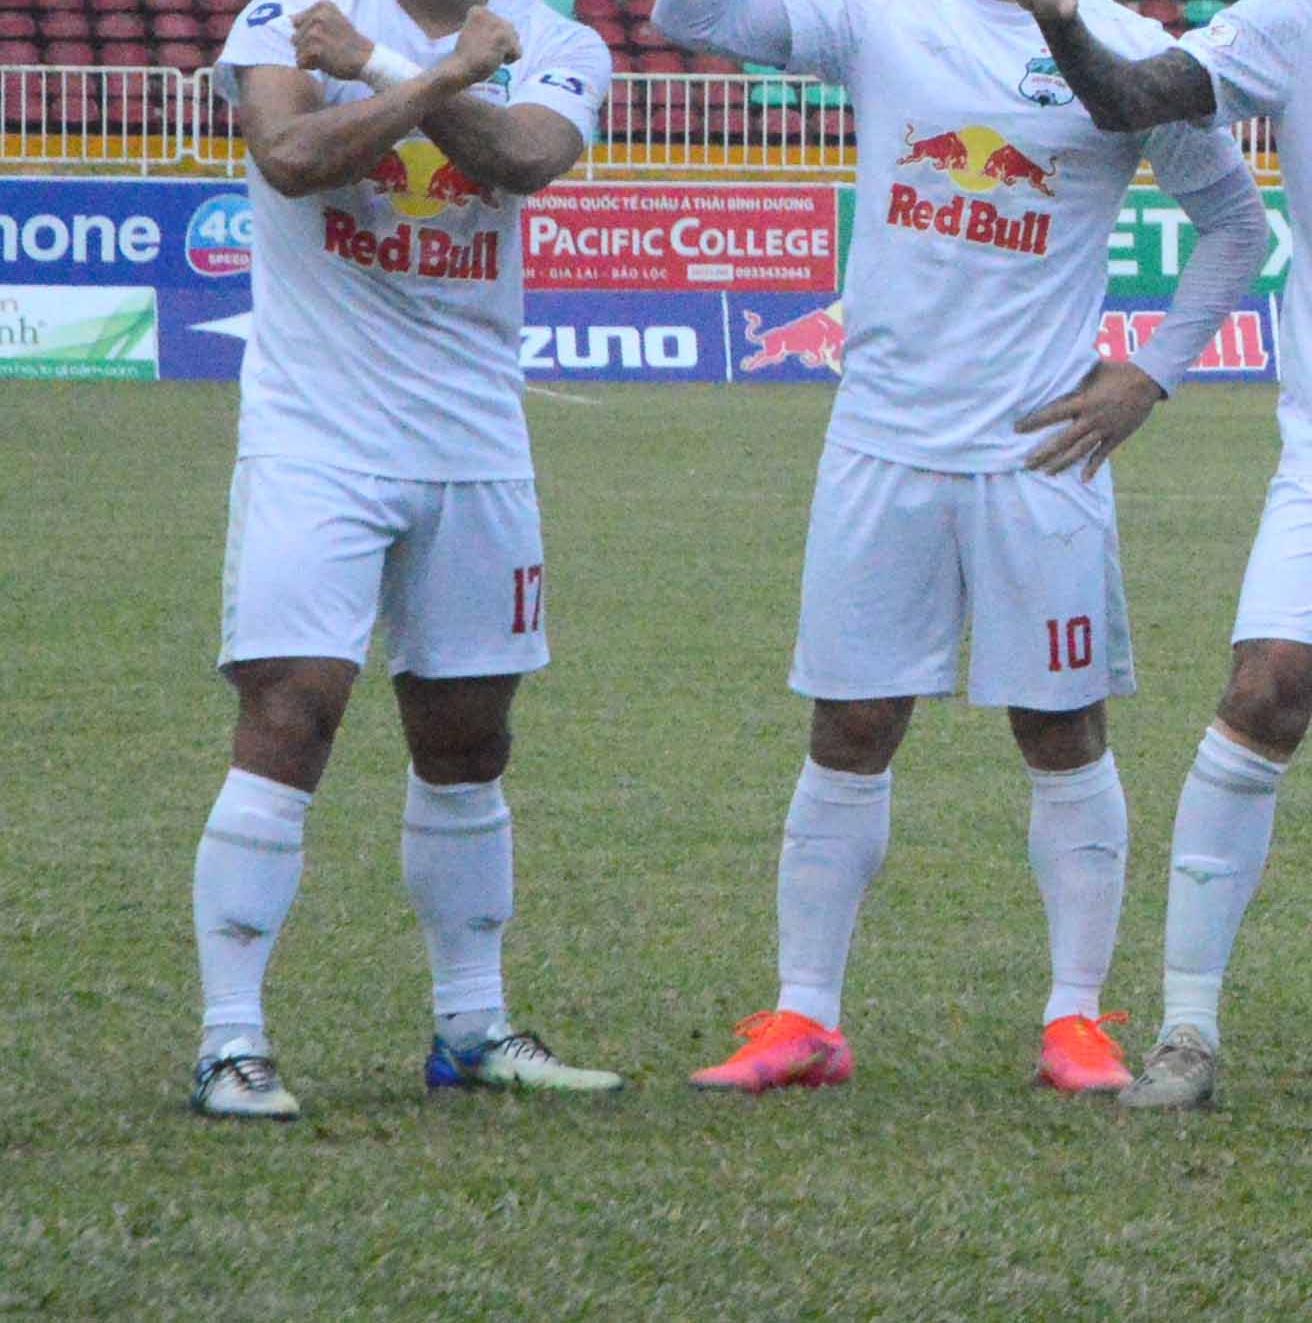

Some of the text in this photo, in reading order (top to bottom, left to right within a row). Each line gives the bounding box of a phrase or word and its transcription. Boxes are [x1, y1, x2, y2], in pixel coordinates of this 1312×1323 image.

[322, 204, 499, 282] Red Bull
[529, 216, 830, 258] PACIFIC COLLEGE
[886, 182, 1051, 257] Red Bull
[511, 564, 544, 635] 17
[1045, 615, 1092, 673] 10
